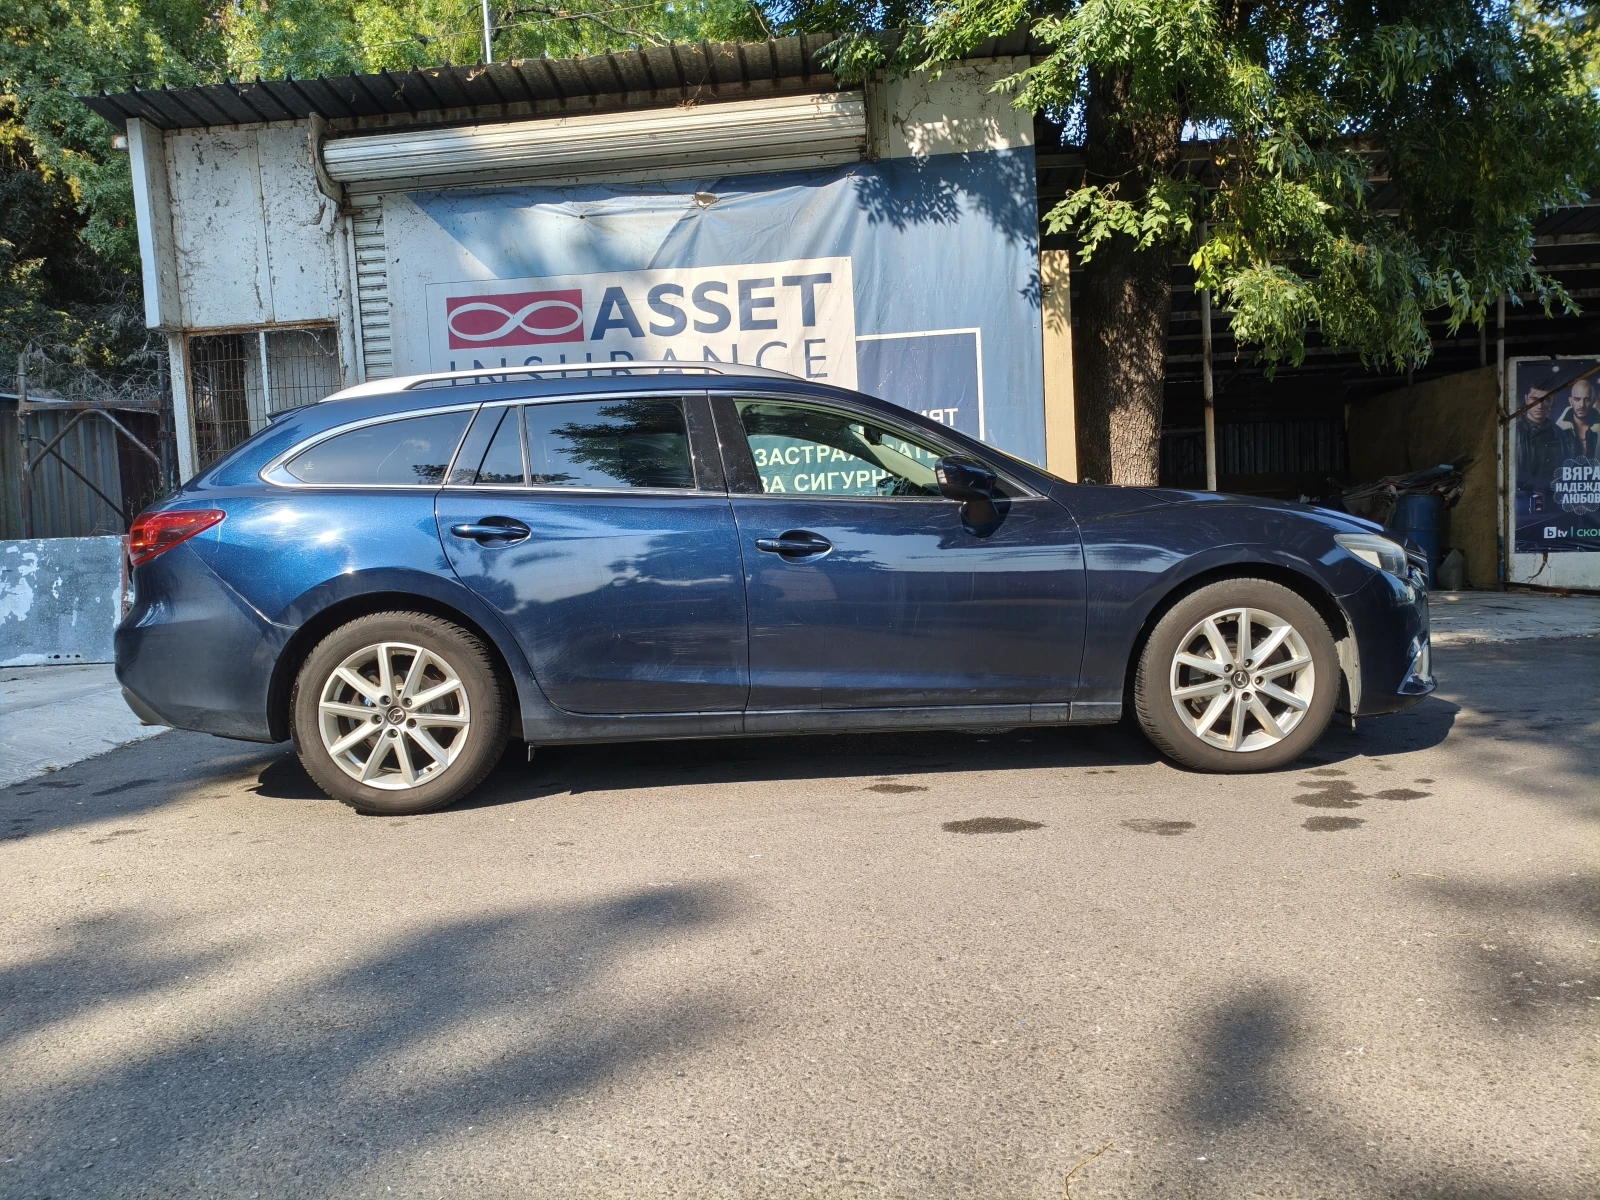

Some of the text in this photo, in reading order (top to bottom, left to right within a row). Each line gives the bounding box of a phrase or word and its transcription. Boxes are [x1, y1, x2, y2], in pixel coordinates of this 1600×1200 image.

[590, 273, 832, 341] ASSET
[794, 469, 894, 492] СИГУРН
[1562, 466, 1600, 481] ВЯРА
